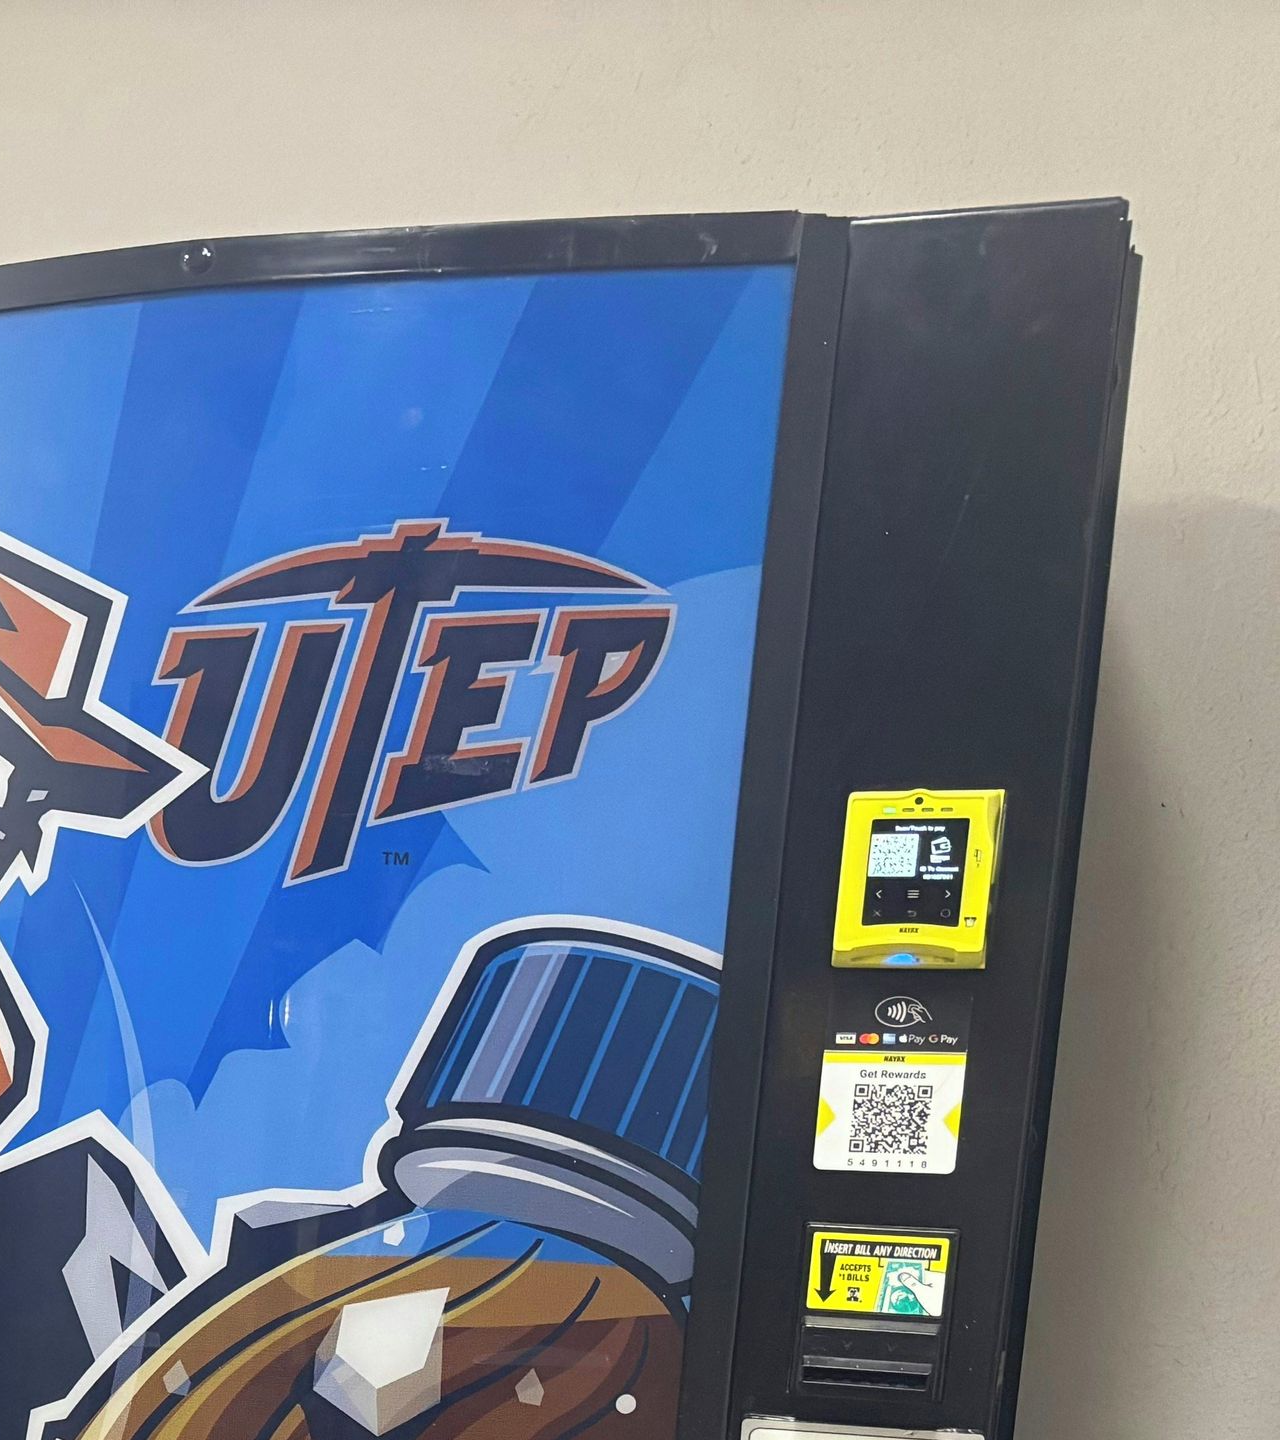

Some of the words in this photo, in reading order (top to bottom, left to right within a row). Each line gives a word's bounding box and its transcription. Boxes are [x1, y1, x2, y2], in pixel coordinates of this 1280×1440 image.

[145, 517, 678, 888] UTEP
[382, 849, 410, 866] TM
[908, 1034, 926, 1045] Pay
[940, 1034, 958, 1045] Pay
[860, 1069, 878, 1079] Get
[881, 1069, 927, 1080] Rewards
[824, 1240, 854, 1255] INSERT
[854, 1244, 871, 1256] BILL
[873, 1245, 893, 1257] ANY
[894, 1246, 938, 1259] DIRECTION
[840, 1263, 872, 1272] ACCEPTS
[846, 1273, 870, 1282] BILLS
